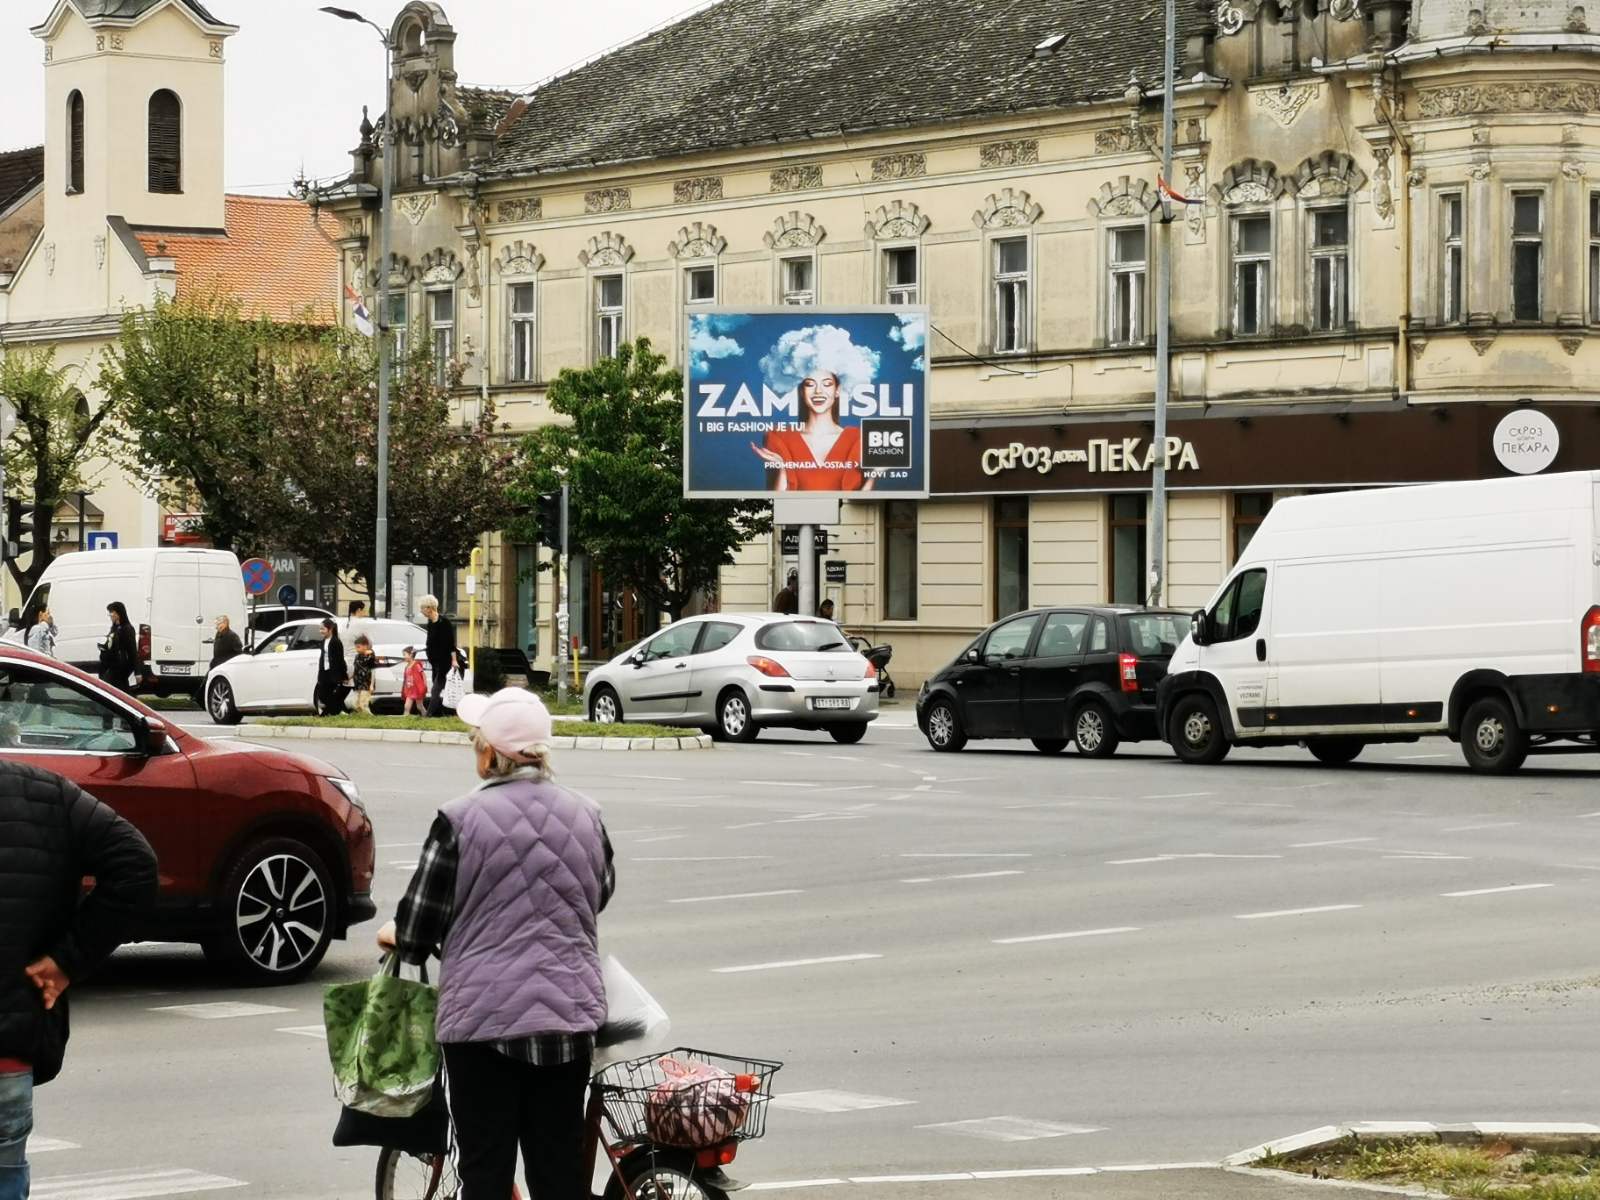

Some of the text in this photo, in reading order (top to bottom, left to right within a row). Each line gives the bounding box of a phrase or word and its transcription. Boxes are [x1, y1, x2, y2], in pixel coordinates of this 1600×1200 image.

[697, 382, 913, 417] ZAMISLI
[706, 422, 724, 432] BIG
[727, 422, 774, 432] FASHION
[775, 422, 787, 432] JE
[868, 431, 904, 447] BIG
[868, 448, 904, 456] FASHION
[764, 461, 817, 469] PROMENADA
